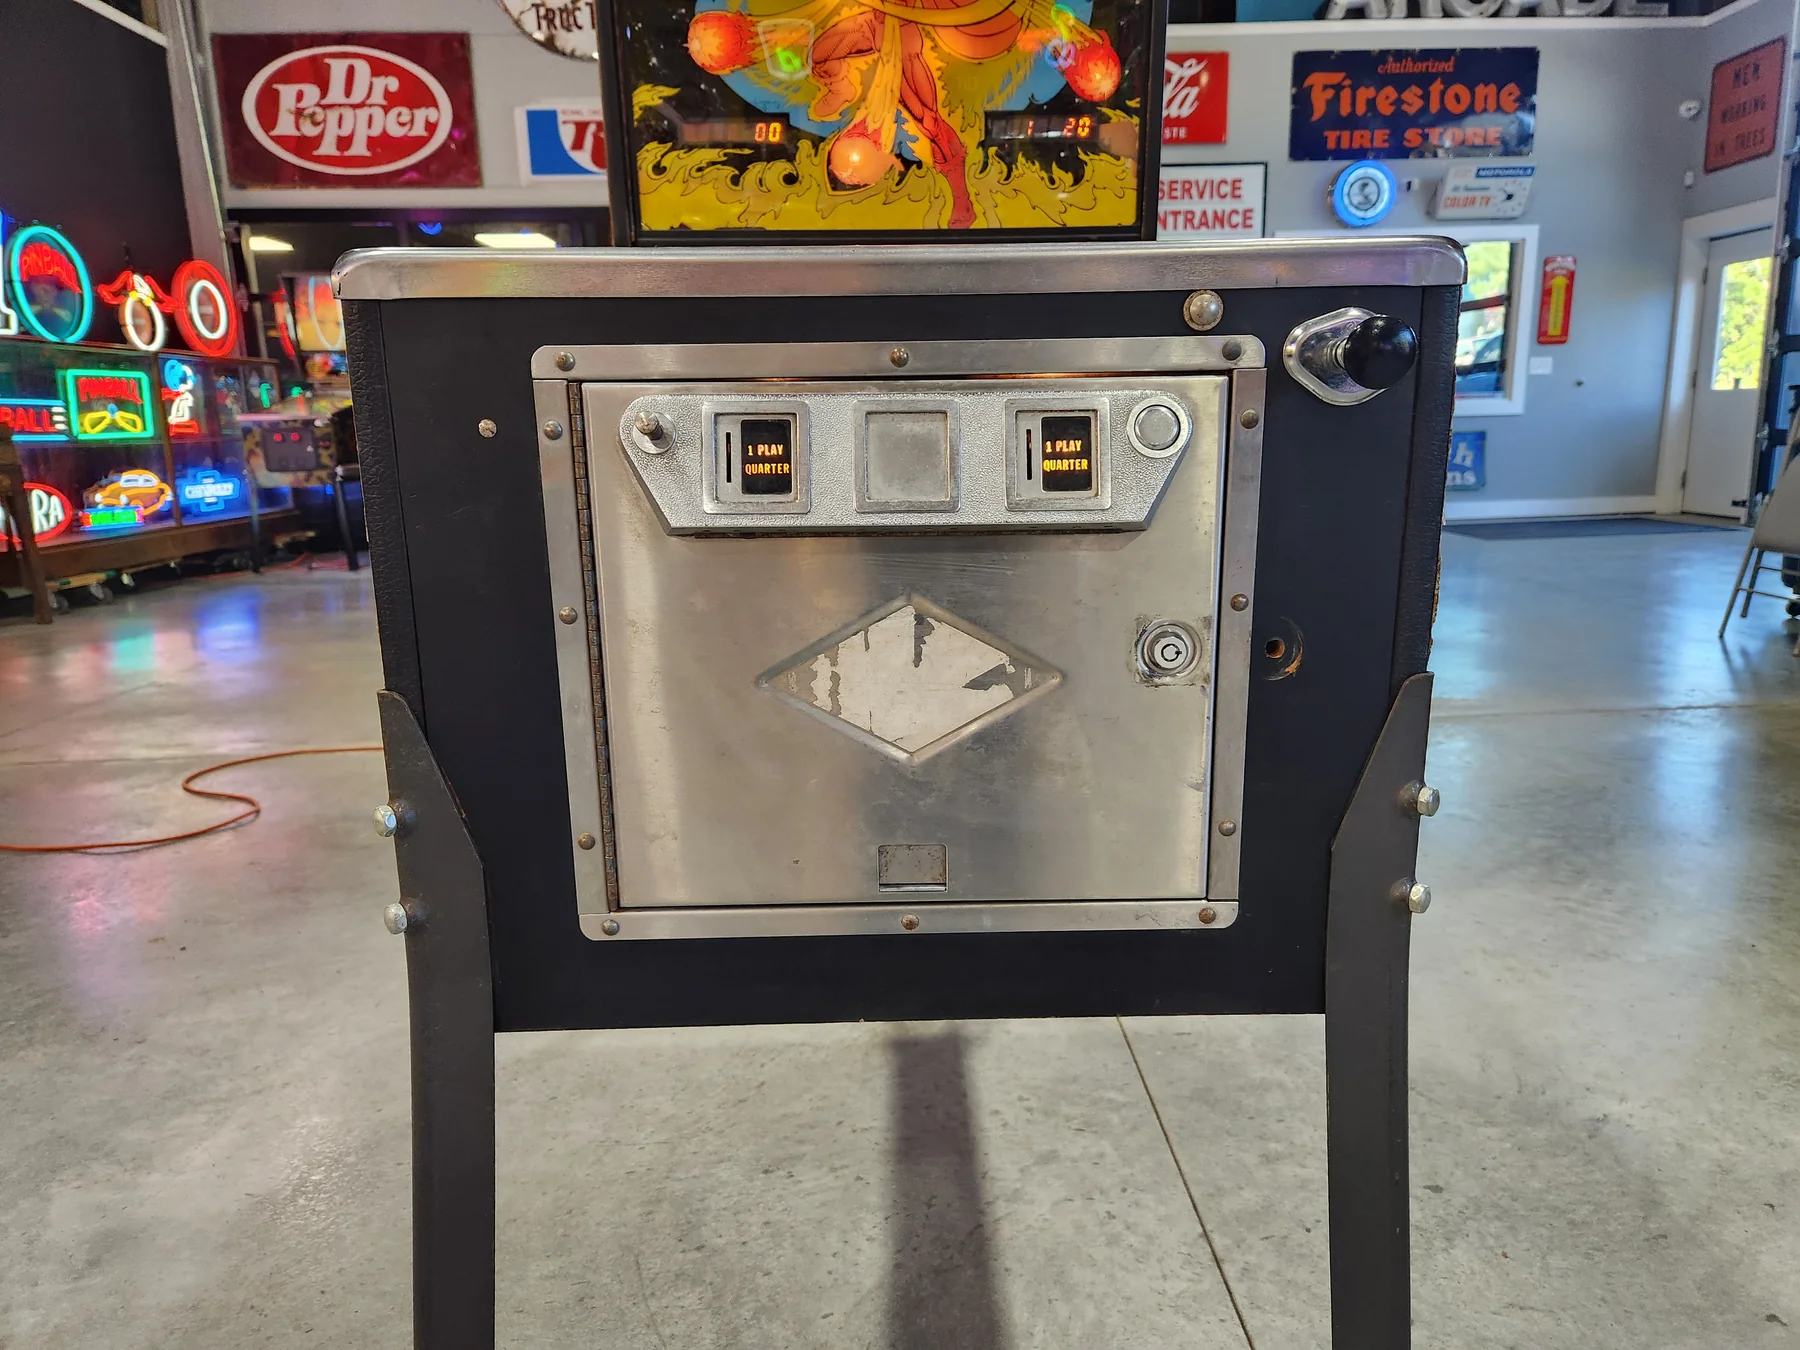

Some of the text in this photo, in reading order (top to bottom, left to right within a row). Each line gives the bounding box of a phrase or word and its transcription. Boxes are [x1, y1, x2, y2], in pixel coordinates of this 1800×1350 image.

[1377, 56, 1456, 74] Authorized
[320, 58, 399, 106] Dr
[1302, 71, 1522, 122] Firestone
[269, 83, 440, 157] Pepper
[1324, 126, 1503, 150] TIRE STORE
[747, 443, 784, 456] 1 PLAY
[1045, 439, 1082, 453] 1 PLAY
[745, 463, 790, 475] QUARTER
[1043, 458, 1088, 472] QUARTER
